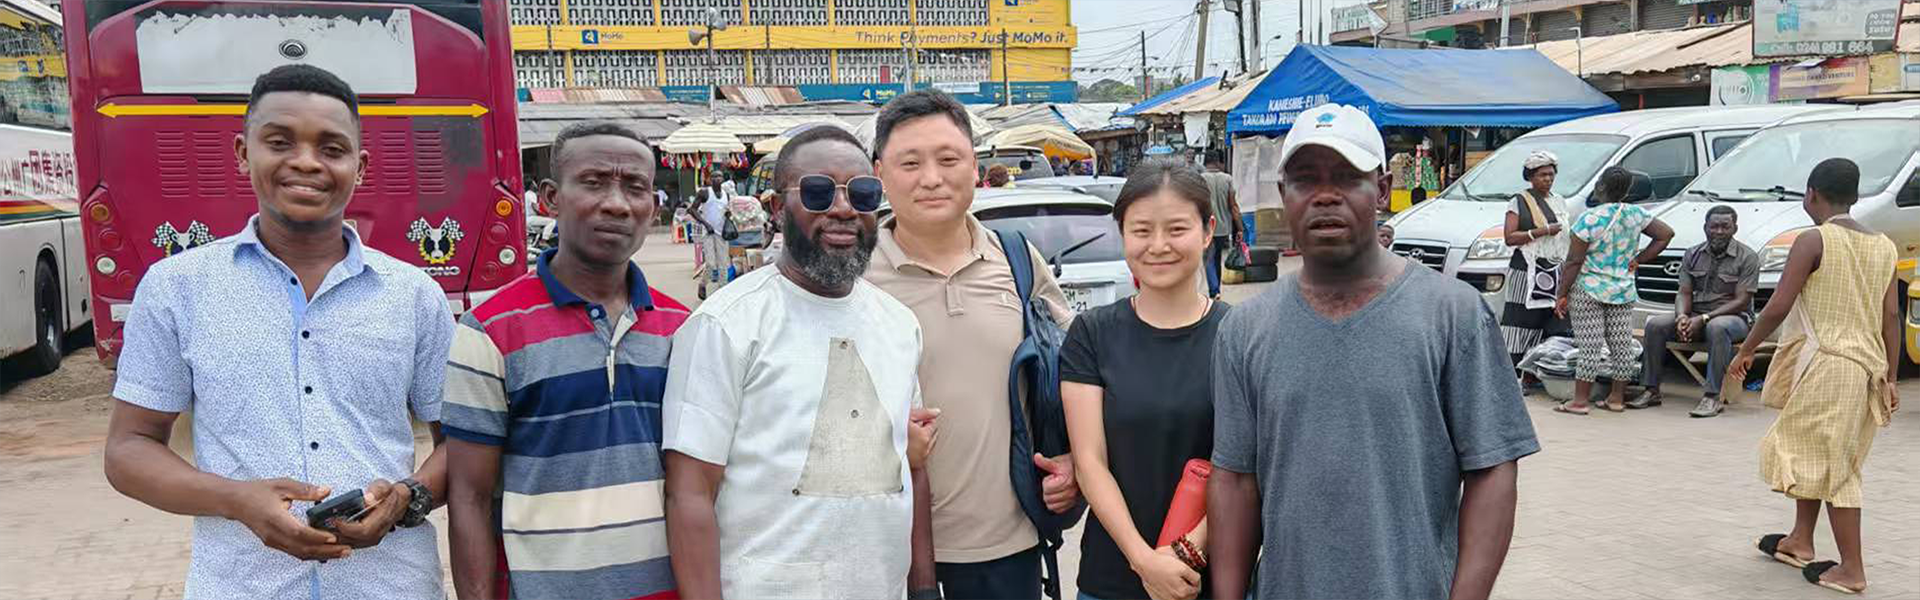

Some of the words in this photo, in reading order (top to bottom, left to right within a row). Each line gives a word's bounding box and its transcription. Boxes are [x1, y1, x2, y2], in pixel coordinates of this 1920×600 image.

[855, 32, 895, 43] Think
[980, 31, 1009, 44] Just
[1012, 32, 1052, 43] MoMo
[1055, 31, 1069, 43] it.
